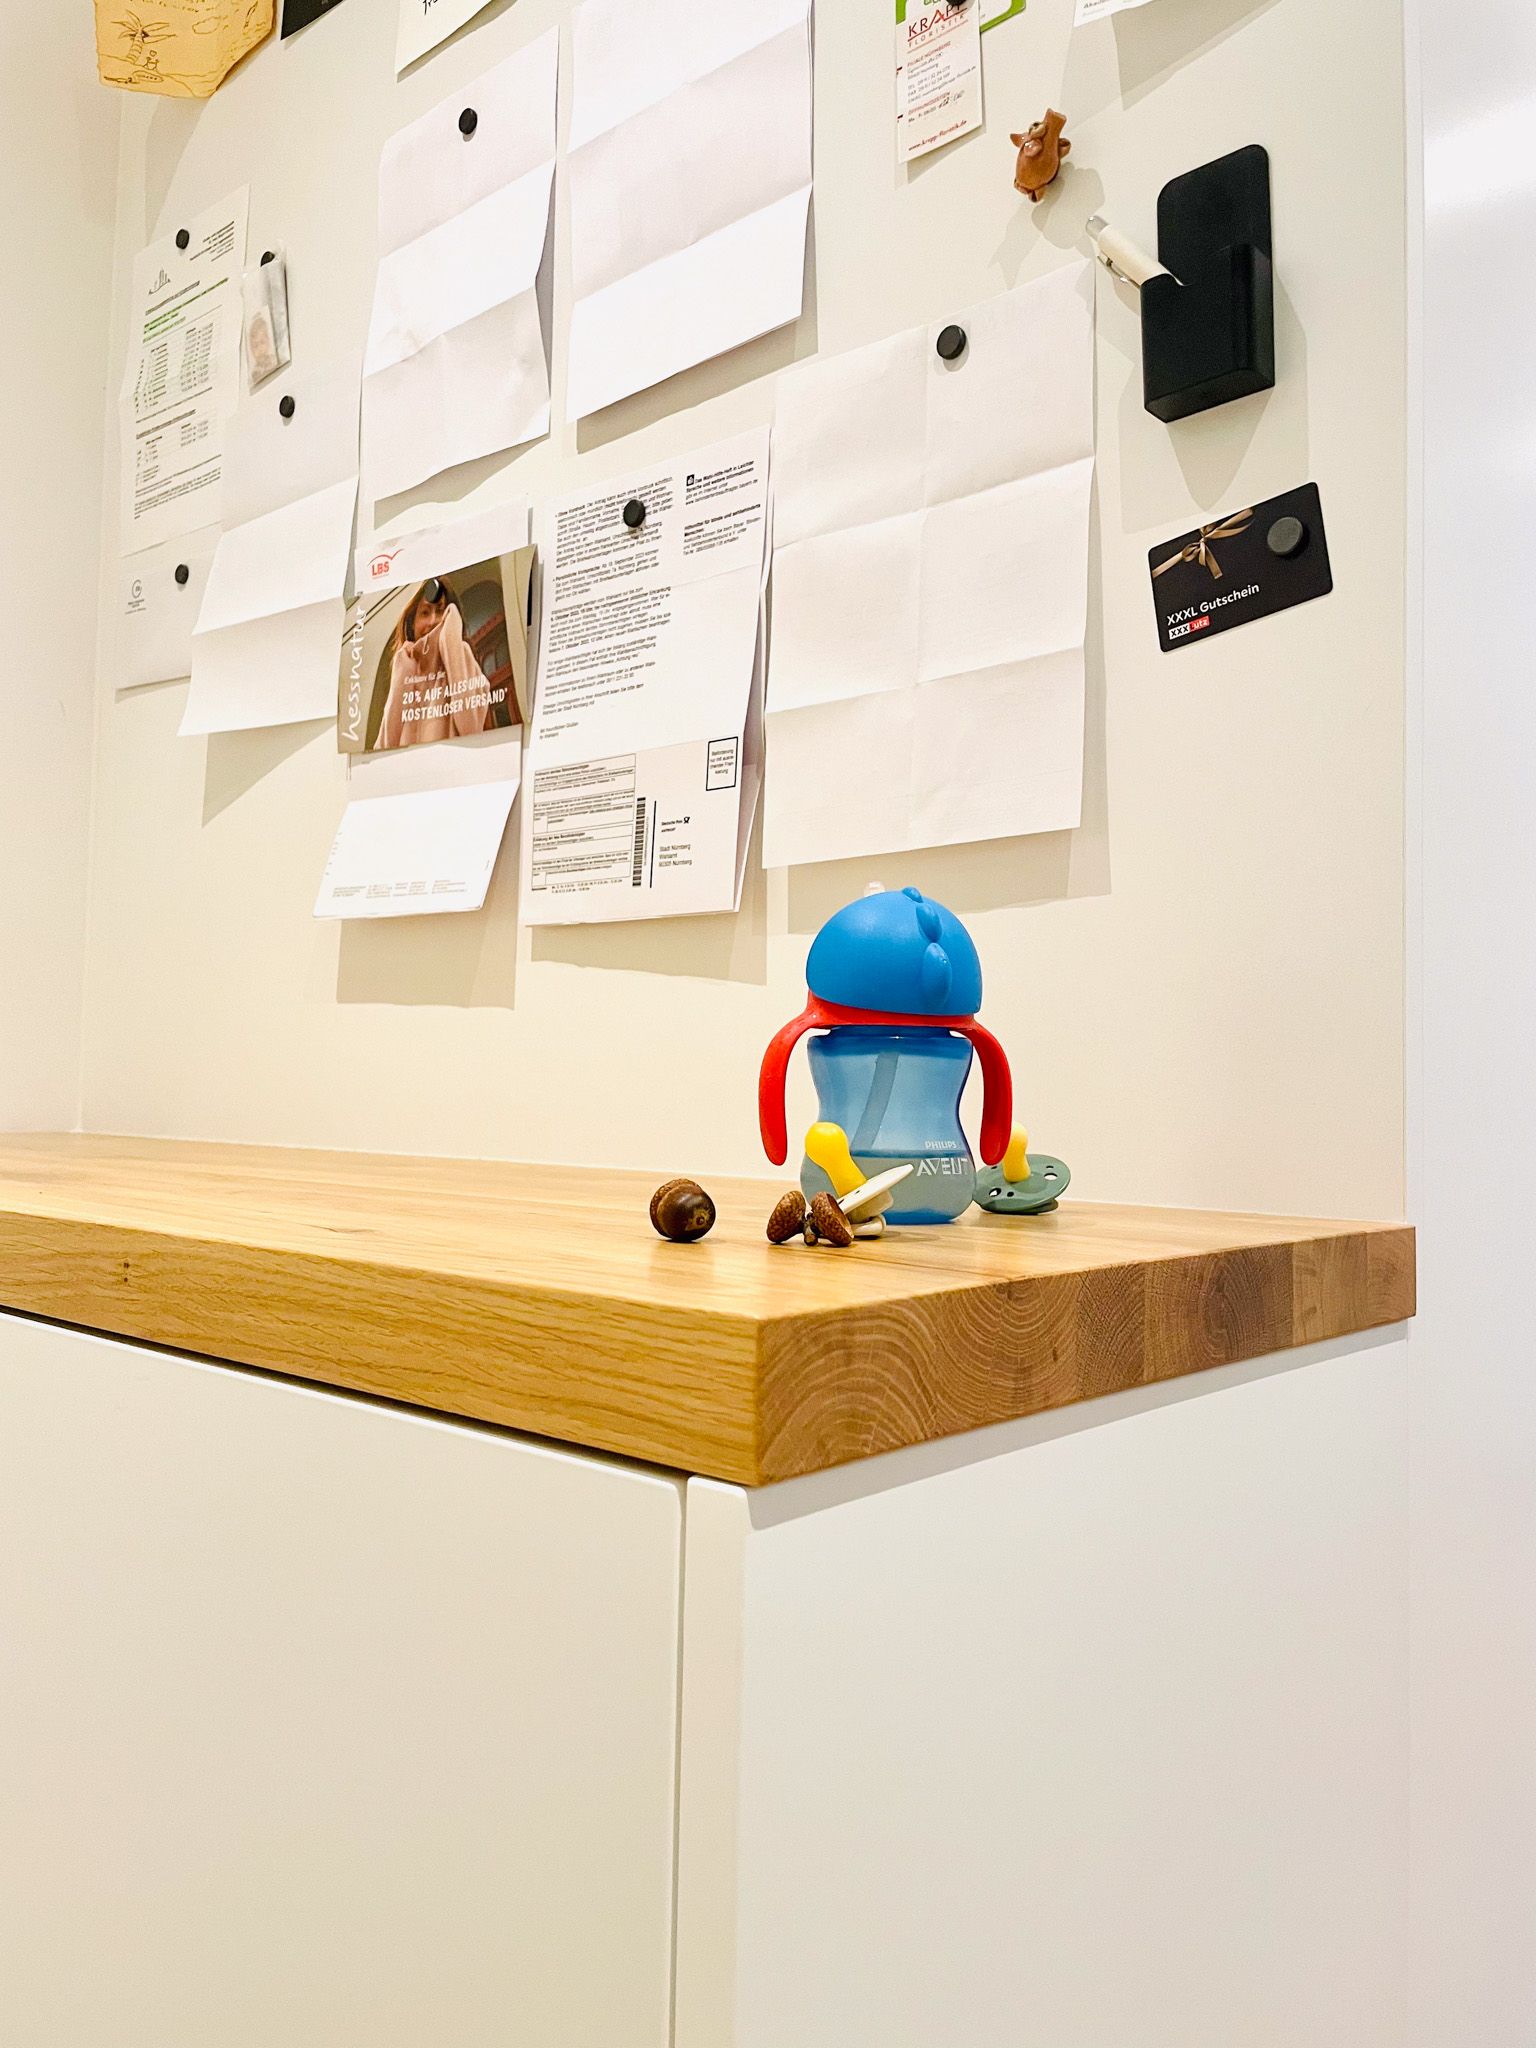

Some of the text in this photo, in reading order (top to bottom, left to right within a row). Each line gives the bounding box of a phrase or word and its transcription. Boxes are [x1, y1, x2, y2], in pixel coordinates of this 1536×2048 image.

[908, 13, 964, 48] FLORISTIK
[371, 561, 390, 577] LBS
[1166, 584, 1260, 626] XXXL Gutschein
[342, 607, 367, 741] hessnatur
[402, 675, 487, 705] 20% AUF ALLES UND
[401, 699, 464, 723] KOSTENLOSER
[925, 1140, 957, 1150] PHILIPS
[916, 1157, 969, 1177] AVENT
